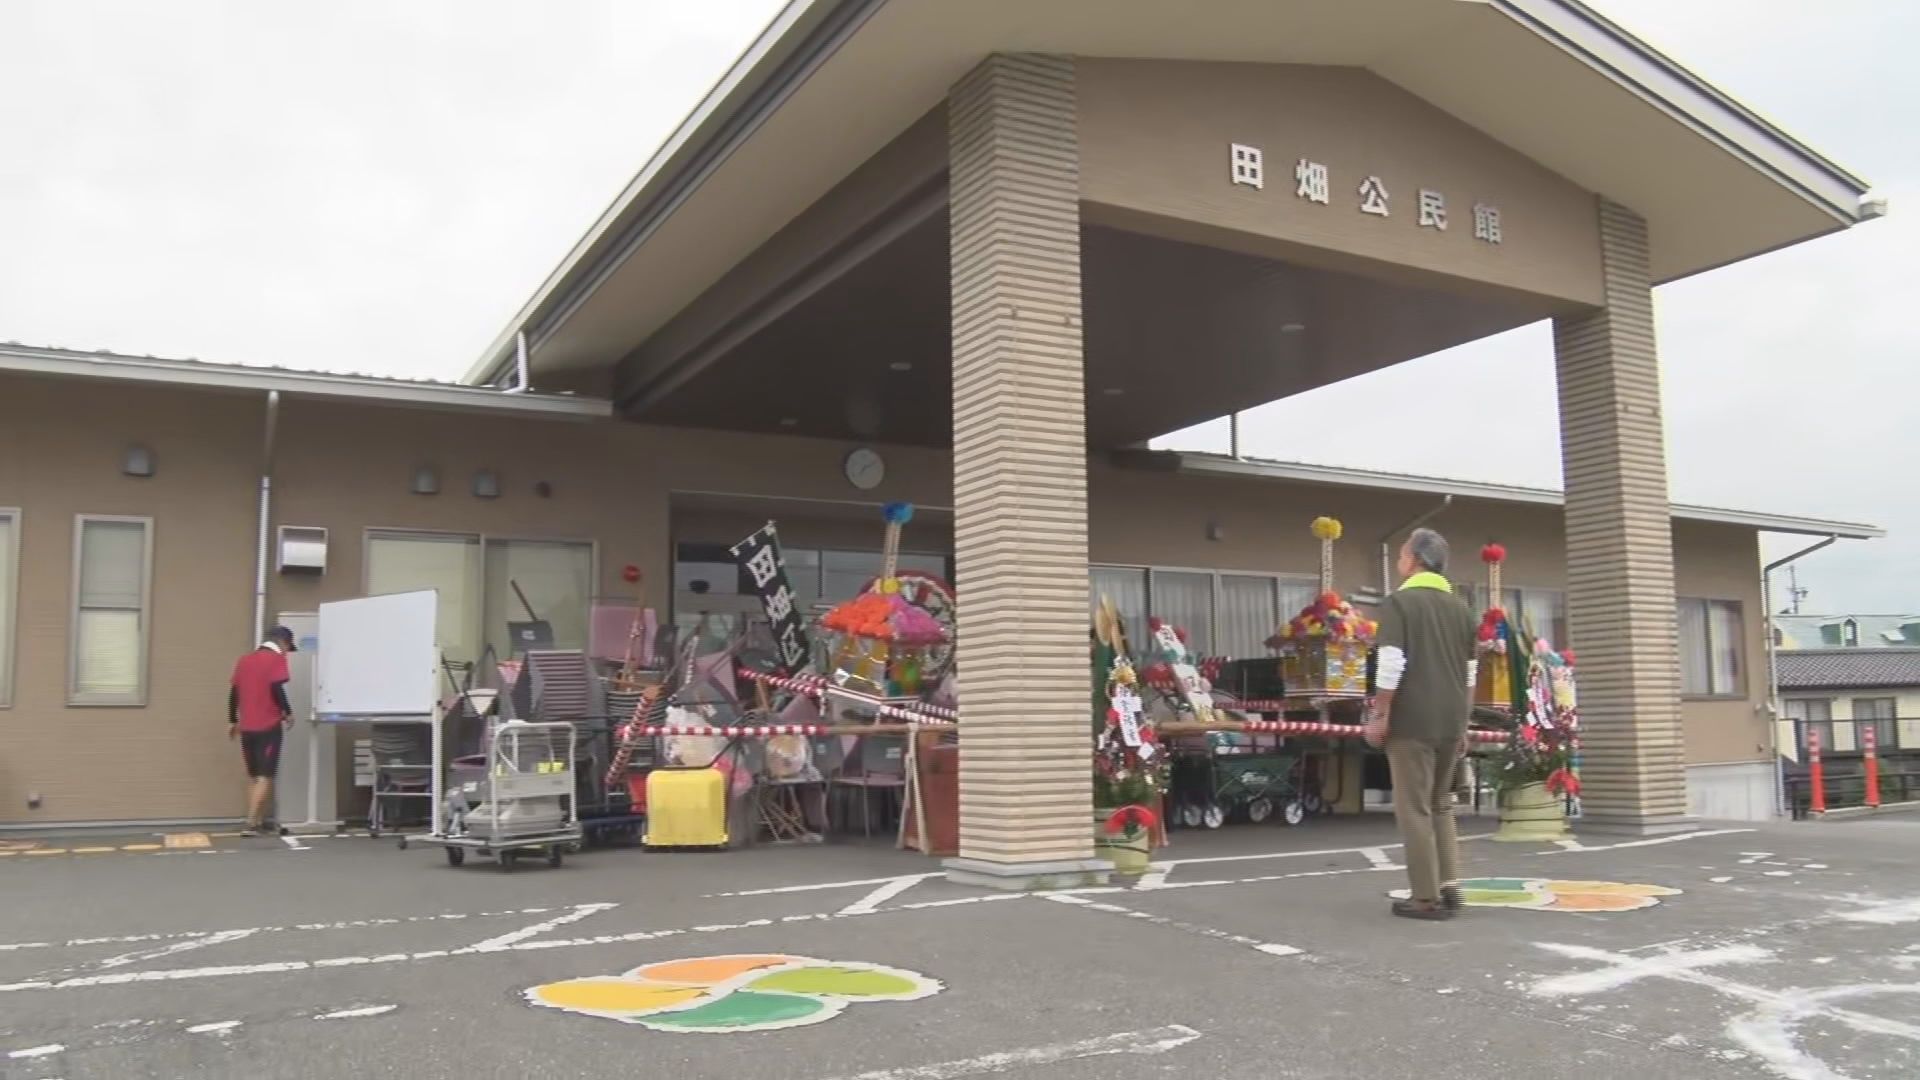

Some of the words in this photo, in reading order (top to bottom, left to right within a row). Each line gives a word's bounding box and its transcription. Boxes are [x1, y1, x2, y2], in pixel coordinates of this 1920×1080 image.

[1230, 142, 1502, 244] 田畑公民館
[746, 544, 805, 667] 田畑区
